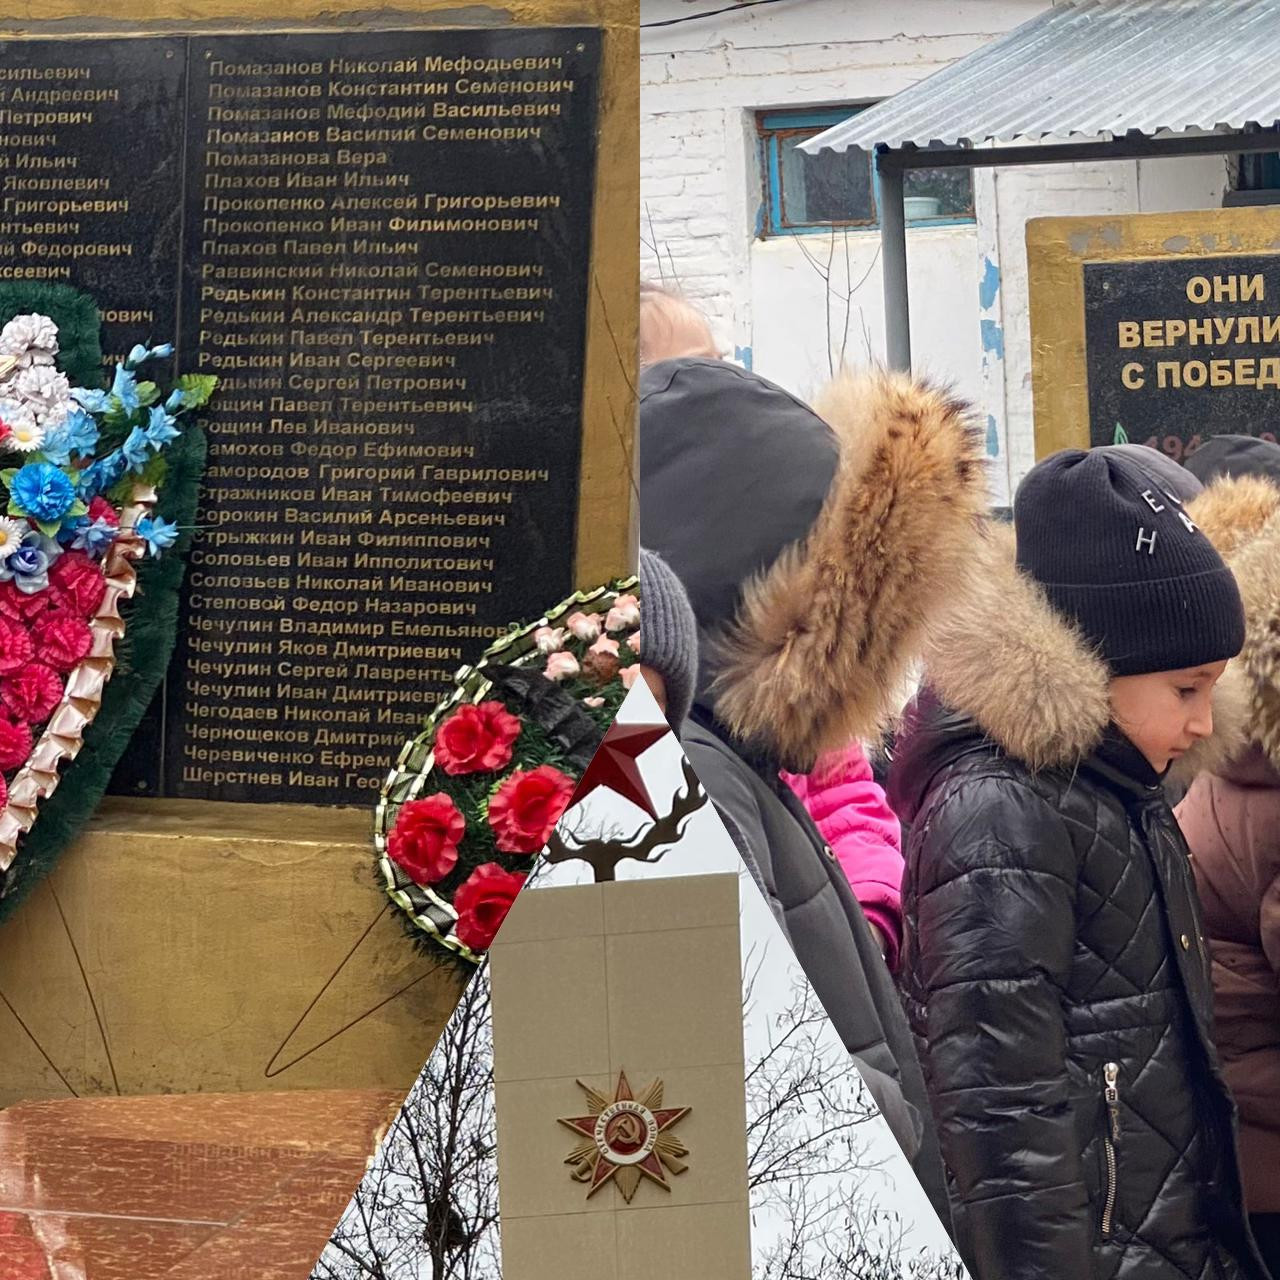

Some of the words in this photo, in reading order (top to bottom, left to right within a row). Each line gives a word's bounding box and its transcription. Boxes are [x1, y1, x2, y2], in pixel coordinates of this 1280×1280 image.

[208, 79, 322, 101] Помазанов
[328, 81, 448, 96] Константин
[455, 79, 574, 94] Семенович
[16, 153, 77, 169] Ильич
[4, 197, 129, 216] Григорьевич
[203, 218, 324, 236] Прокопенко
[331, 217, 382, 233] Иван
[388, 216, 538, 231] Филимонович
[1186, 274, 1264, 304] ОНИ
[199, 352, 283, 369] Редькин
[290, 352, 340, 367] Иван
[346, 352, 455, 371] Сергеевич
[1122, 362, 1145, 389] С
[191, 572, 290, 589] Соловьев
[297, 574, 383, 591] Николай
[390, 576, 492, 593] Иванович
[190, 594, 285, 611] Степовой
[292, 596, 359, 615] Федор
[365, 597, 476, 617] Назарович
[188, 637, 272, 656] Чечулин
[278, 639, 328, 655] Яков
[333, 641, 461, 661] Дмитриевич
